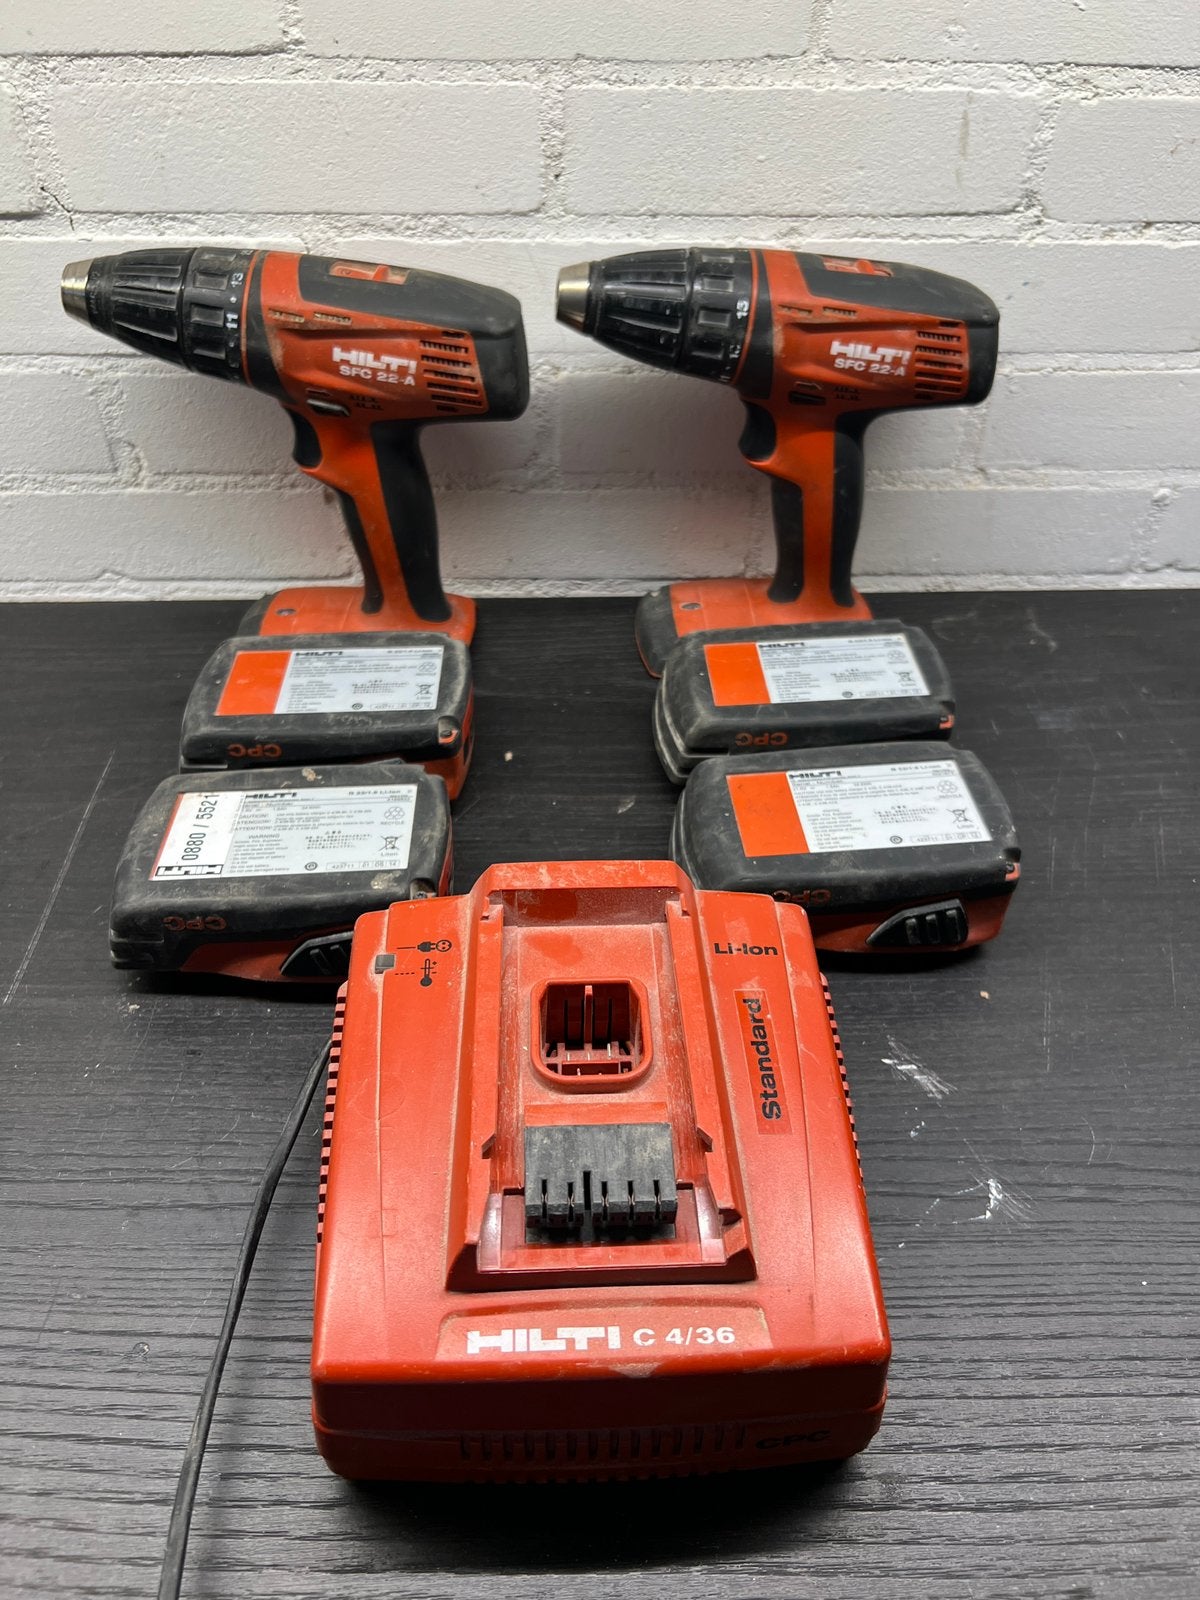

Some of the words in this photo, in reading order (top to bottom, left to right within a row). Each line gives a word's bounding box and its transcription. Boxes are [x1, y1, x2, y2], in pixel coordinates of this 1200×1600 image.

[230, 272, 244, 288] 13
[225, 312, 239, 329] 11
[332, 346, 418, 375] HILTI
[830, 340, 912, 365] HILTI
[339, 364, 373, 380] SFC
[376, 371, 416, 386] 22-A
[834, 358, 867, 372] SFC
[868, 362, 907, 377] 22-A
[735, 732, 788, 746] CPC
[227, 743, 281, 757] CPC
[788, 770, 842, 779] HILTI
[244, 791, 298, 800] HILTI
[181, 832, 207, 861] 0880
[195, 794, 220, 820] 5521
[155, 864, 224, 877] HILTI
[162, 916, 227, 931] CPC
[714, 942, 778, 956] Li-Ion
[742, 998, 782, 1120] Standard
[466, 1325, 622, 1354] HILTI
[632, 1328, 657, 1346] C
[664, 1326, 736, 1346] 4/36
[753, 1430, 831, 1449] CPC
